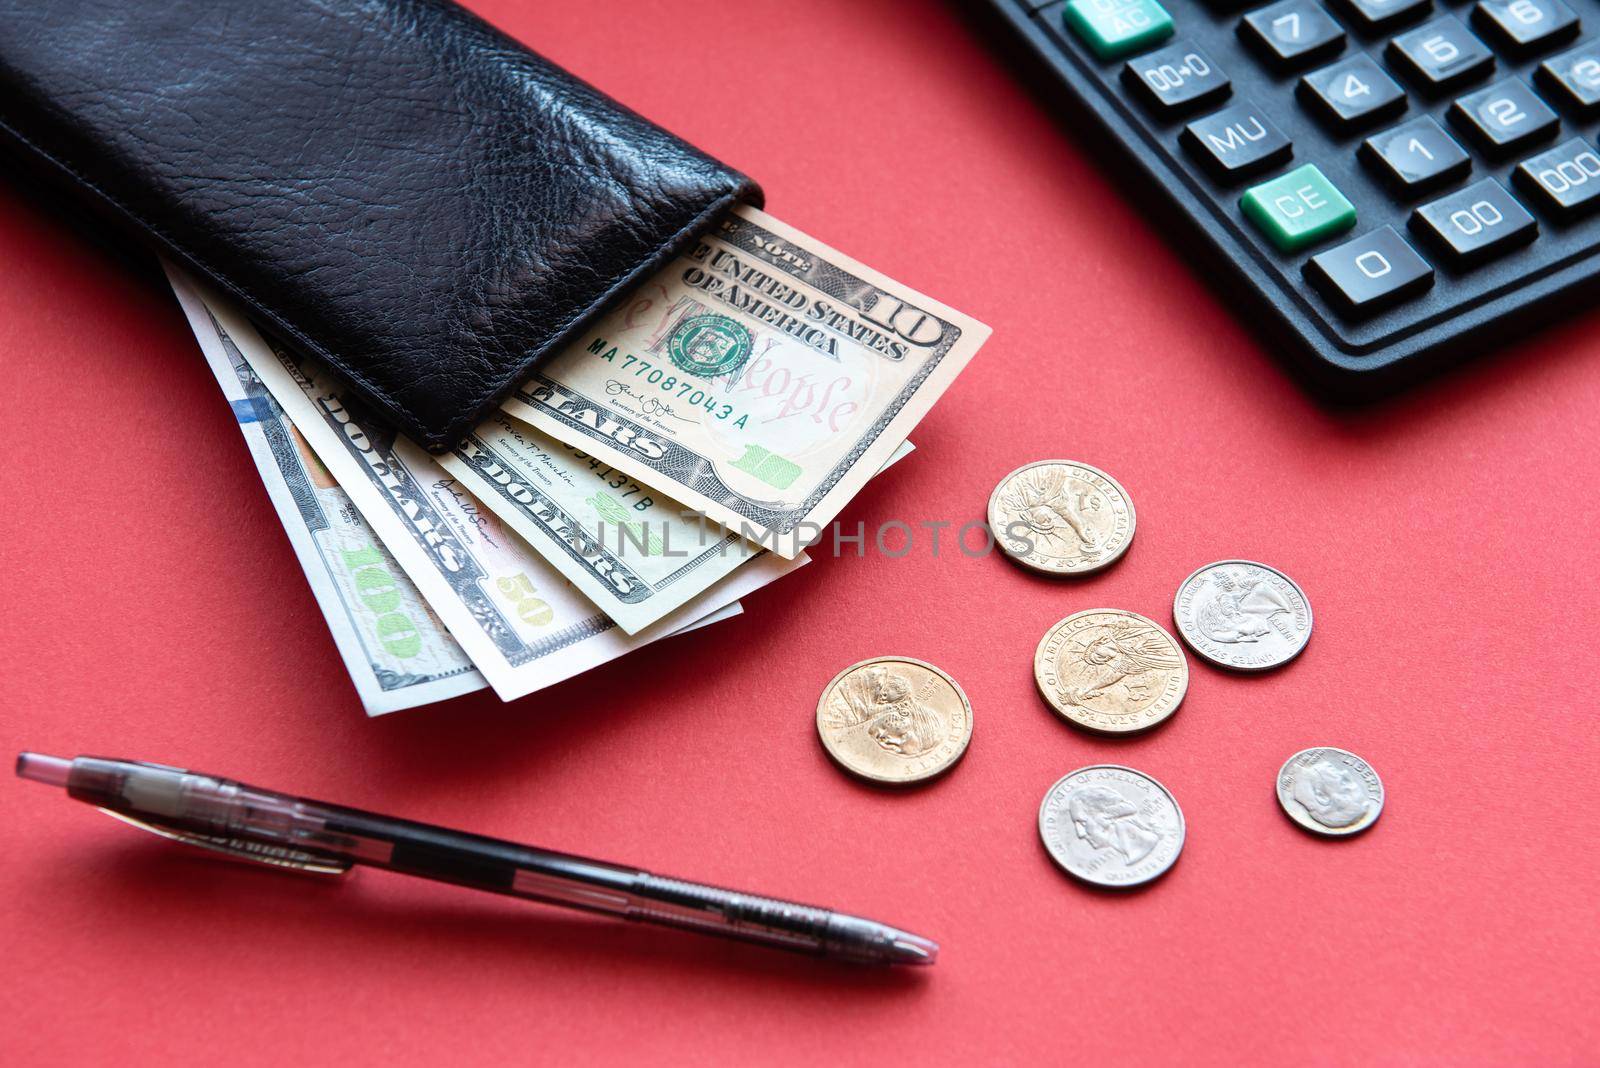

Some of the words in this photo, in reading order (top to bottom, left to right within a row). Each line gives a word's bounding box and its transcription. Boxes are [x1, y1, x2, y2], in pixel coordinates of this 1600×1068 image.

[1113, 8, 1151, 36] AC
[1272, 12, 1300, 39] 7
[1508, 0, 1543, 24] 6
[1423, 36, 1459, 62] 5
[1344, 74, 1370, 98] 4
[1487, 98, 1527, 126] 2
[1207, 116, 1267, 154] MU
[1409, 138, 1434, 160] 1
[1539, 152, 1600, 193] 000
[1274, 184, 1328, 219] CE
[1451, 200, 1503, 236] 00
[750, 234, 812, 273] NOTE
[1355, 250, 1392, 279] 0
[682, 266, 722, 293] OF
[714, 284, 840, 362] AMERICA
[711, 249, 809, 312] UNITED
[807, 299, 910, 362] STATES
[858, 292, 945, 348] 10
[587, 338, 618, 362] MA
[621, 354, 733, 420] 77087043
[733, 414, 749, 430] A
[608, 398, 635, 414] Secretary
[498, 438, 520, 457] Secretary
[318, 394, 463, 572] DOLLARS
[727, 444, 803, 490] 10
[1072, 468, 1120, 503] UNITED
[1076, 493, 1102, 512] $1
[344, 502, 361, 527] SERIES
[633, 496, 654, 511] B
[482, 457, 636, 596] DOLLARS
[339, 542, 423, 660] 100
[495, 571, 555, 628] 50
[1044, 617, 1095, 664] AMERICA
[1044, 670, 1056, 686] OF
[1145, 675, 1181, 719] UNITED
[904, 712, 963, 776] LIBERTY
[1096, 770, 1151, 793] AMERICA
